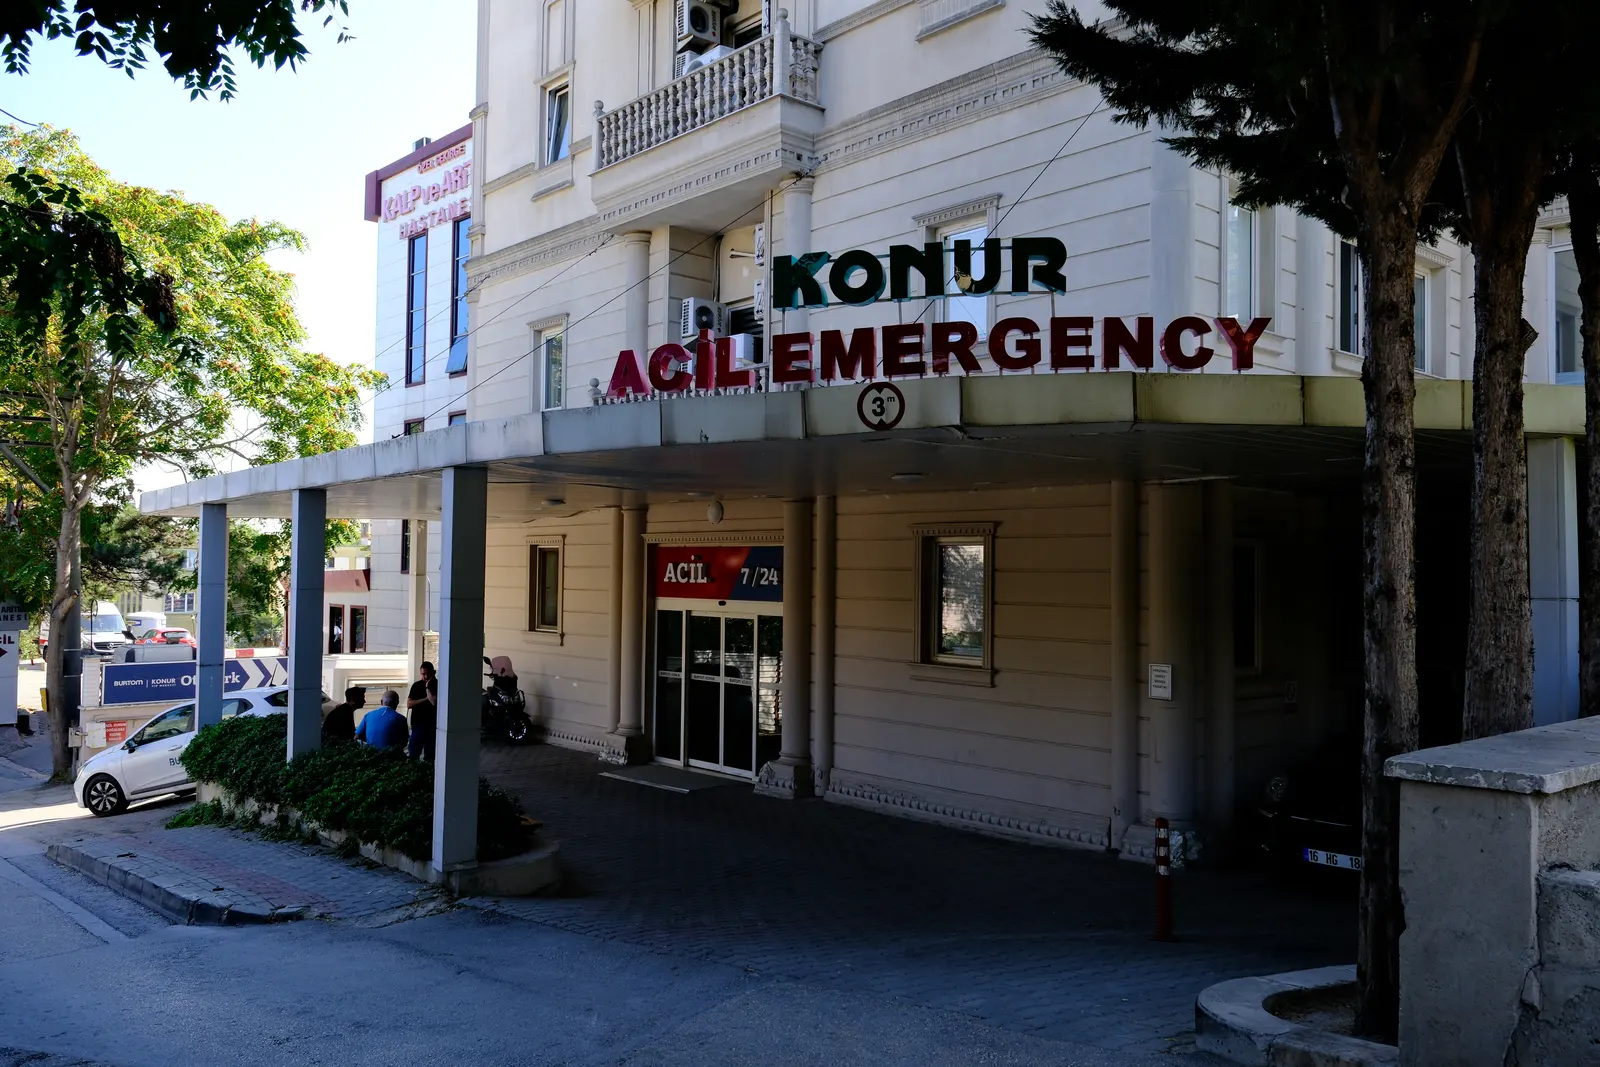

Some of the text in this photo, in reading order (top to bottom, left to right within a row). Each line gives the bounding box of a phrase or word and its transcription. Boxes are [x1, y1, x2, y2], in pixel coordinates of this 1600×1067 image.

[383, 185, 421, 222] KALP
[773, 237, 1067, 311] KONUR
[606, 316, 1272, 398] ACİL EMERGENCY
[664, 555, 707, 583] ACİL
[1309, 850, 1362, 870] 16 HG 18
